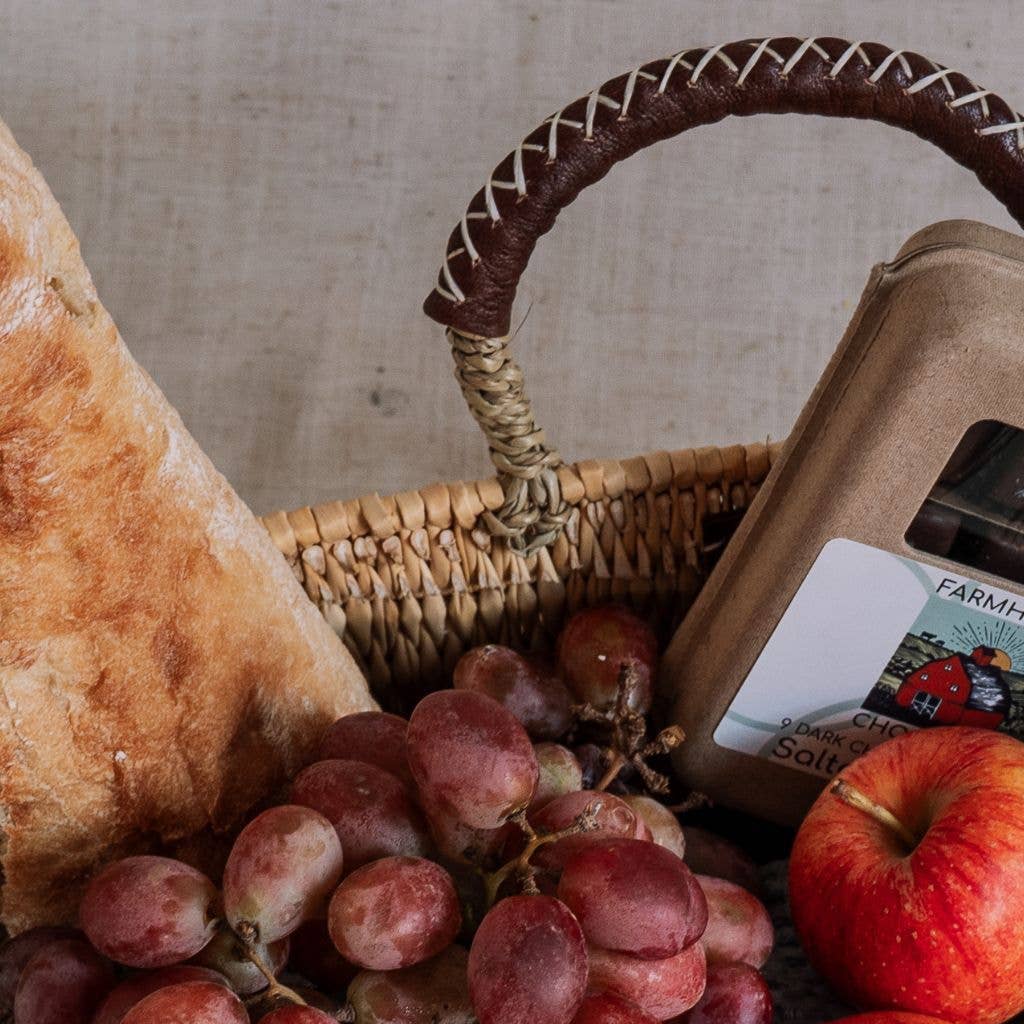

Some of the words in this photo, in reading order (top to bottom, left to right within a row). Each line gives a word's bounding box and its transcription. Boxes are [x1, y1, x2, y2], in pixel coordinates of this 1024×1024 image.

[780, 717, 792, 730] 9
[795, 722, 847, 747] DARK
[852, 712, 909, 738] CHO
